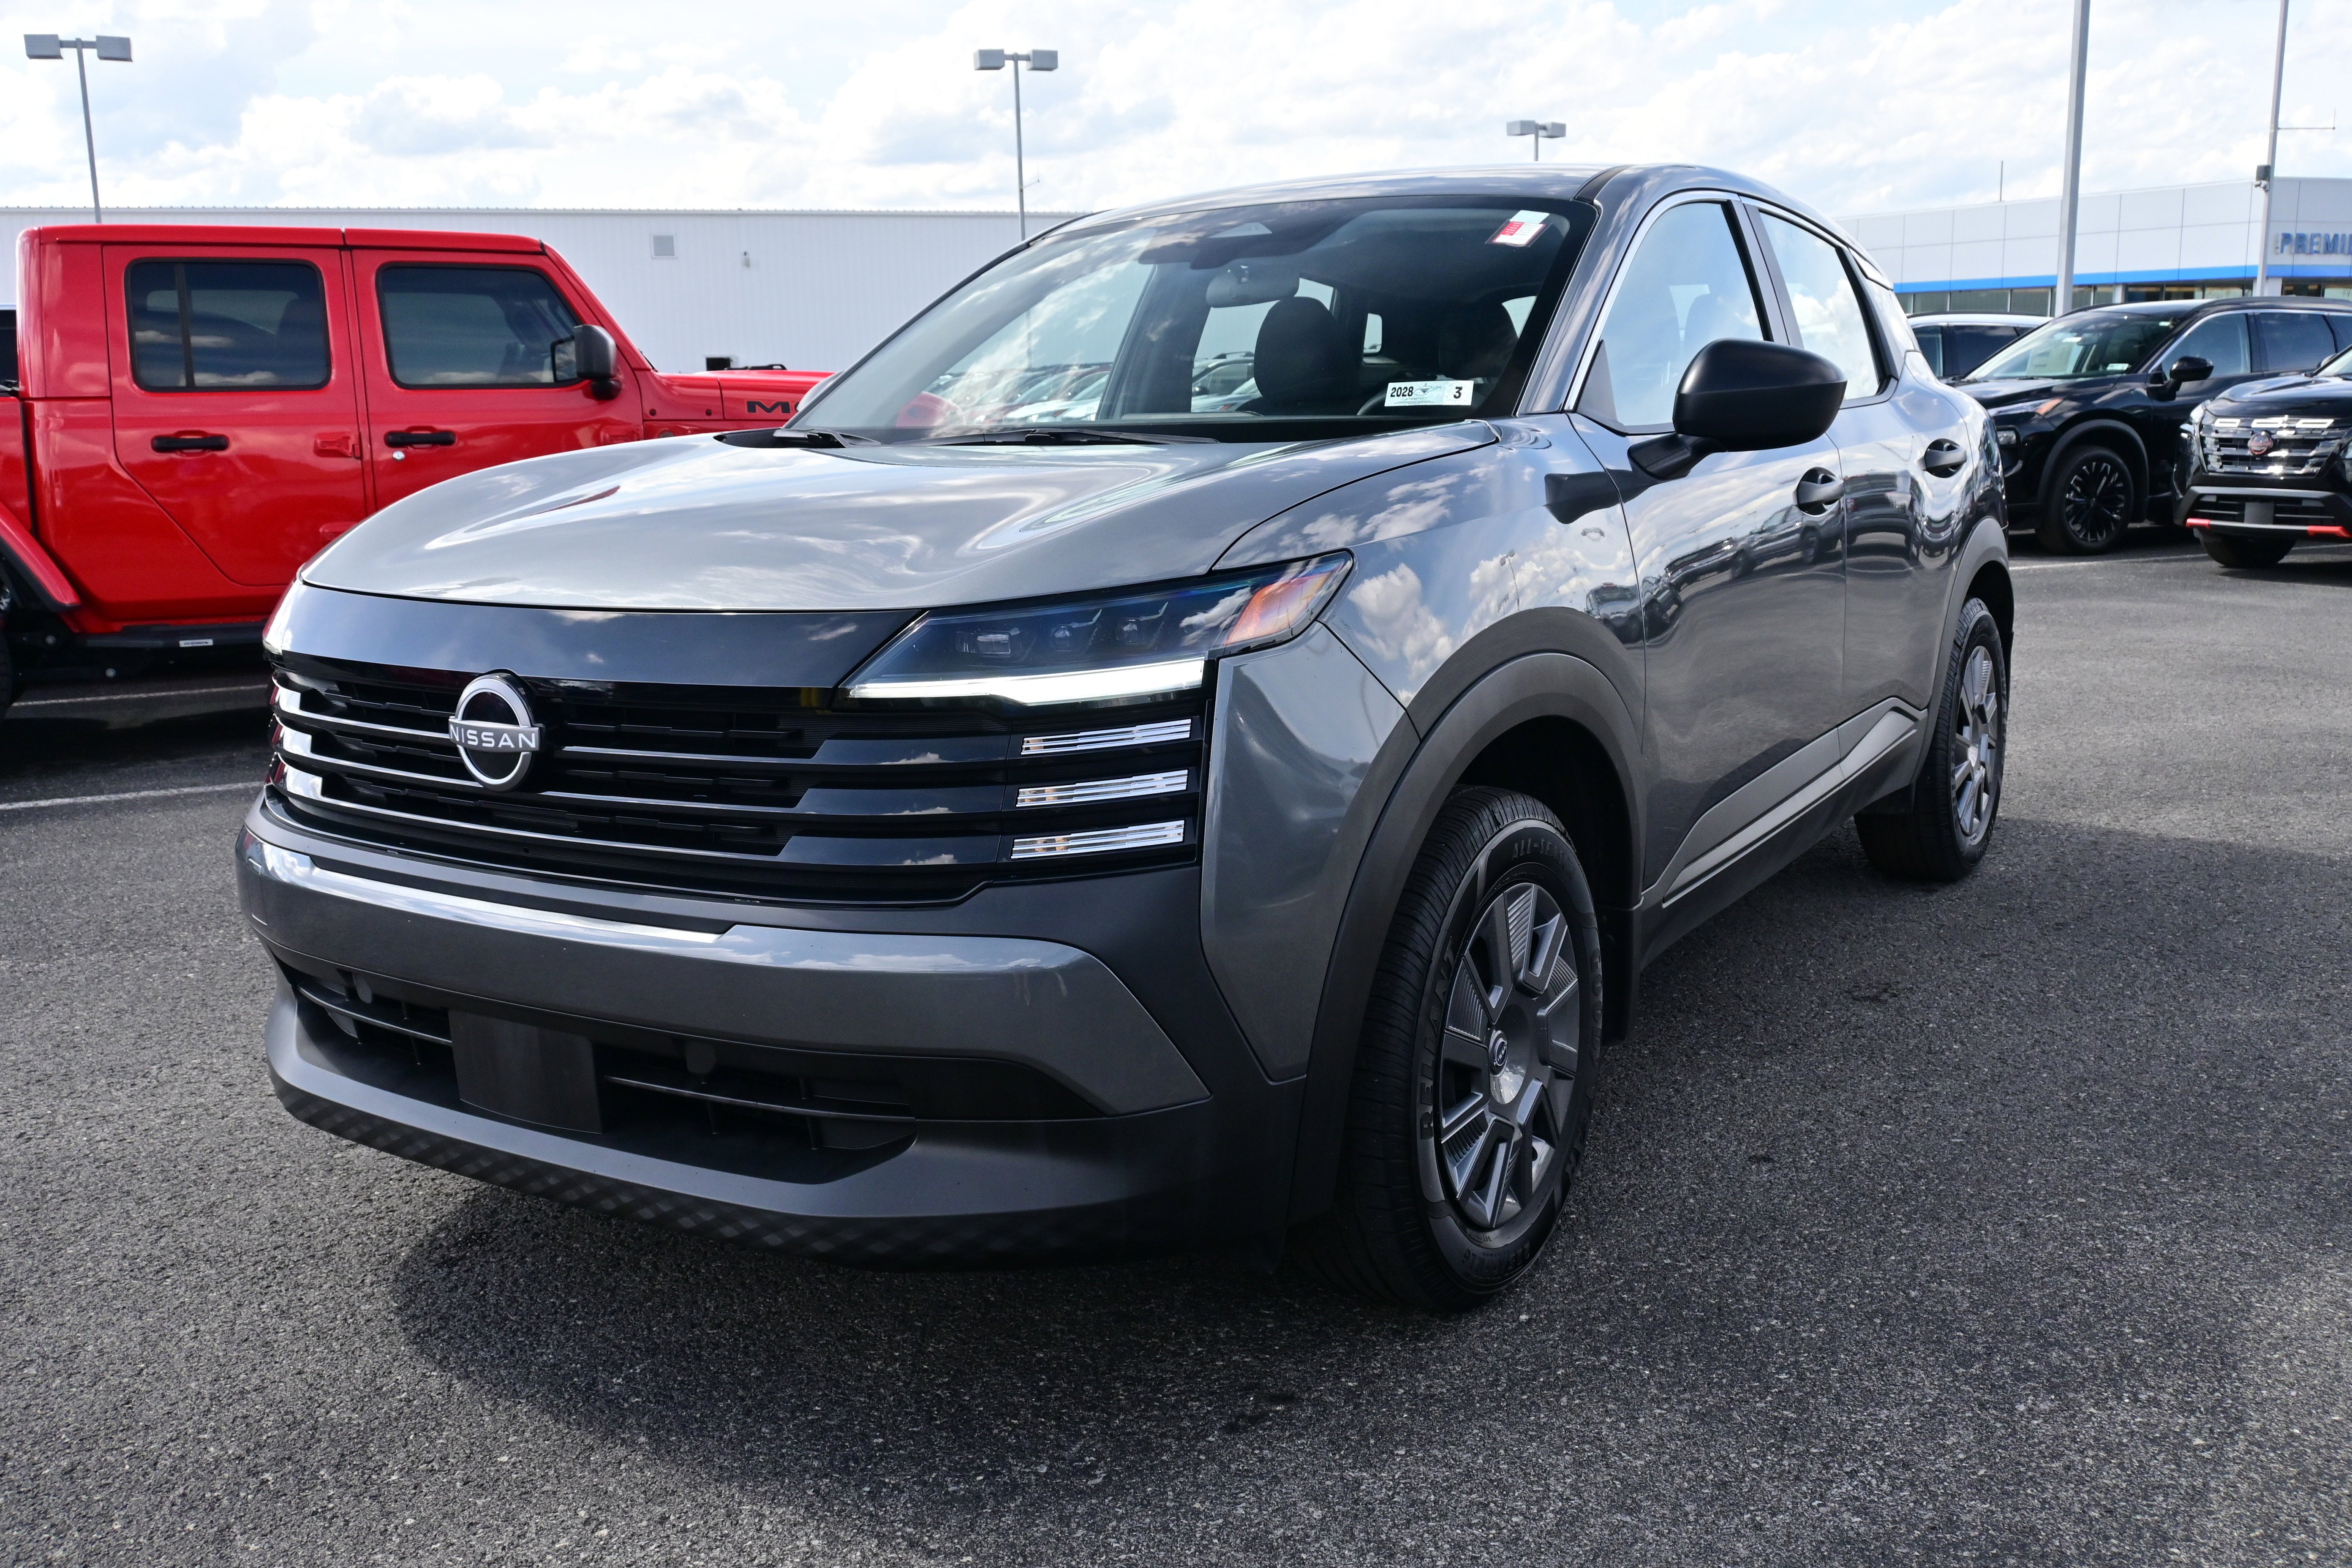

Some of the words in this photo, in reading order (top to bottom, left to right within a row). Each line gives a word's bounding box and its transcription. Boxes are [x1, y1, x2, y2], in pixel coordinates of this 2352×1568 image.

[1390, 386, 1414, 397] 2028
[1453, 386, 1463, 399] 3
[747, 400, 800, 413] M
[450, 724, 536, 748] NISSAN
[1493, 1040, 1508, 1067] NISSAN
